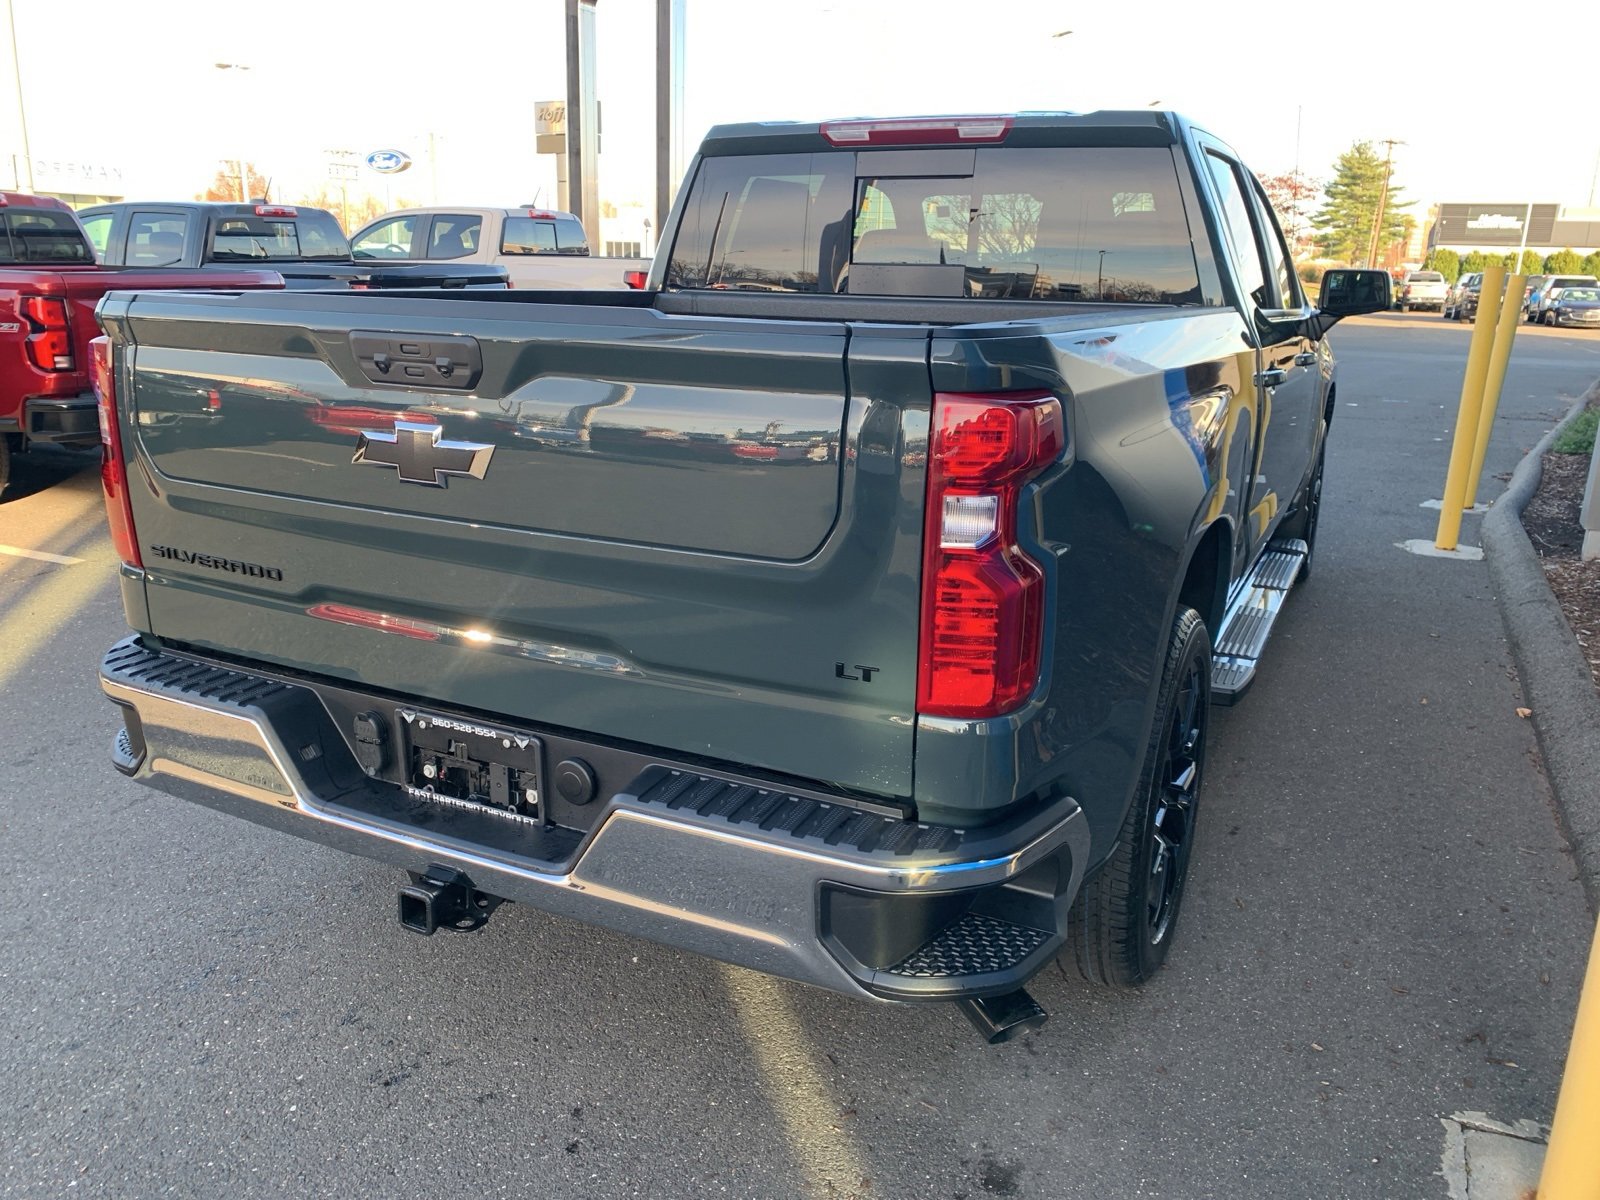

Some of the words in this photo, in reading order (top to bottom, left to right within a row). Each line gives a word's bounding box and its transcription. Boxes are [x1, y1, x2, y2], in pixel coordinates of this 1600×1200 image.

[538, 106, 566, 123] Hoff
[34, 160, 123, 180] OFFMAN
[150, 545, 283, 581] SILVERADO
[835, 661, 880, 682] LT
[431, 717, 497, 739] 860-528-1554
